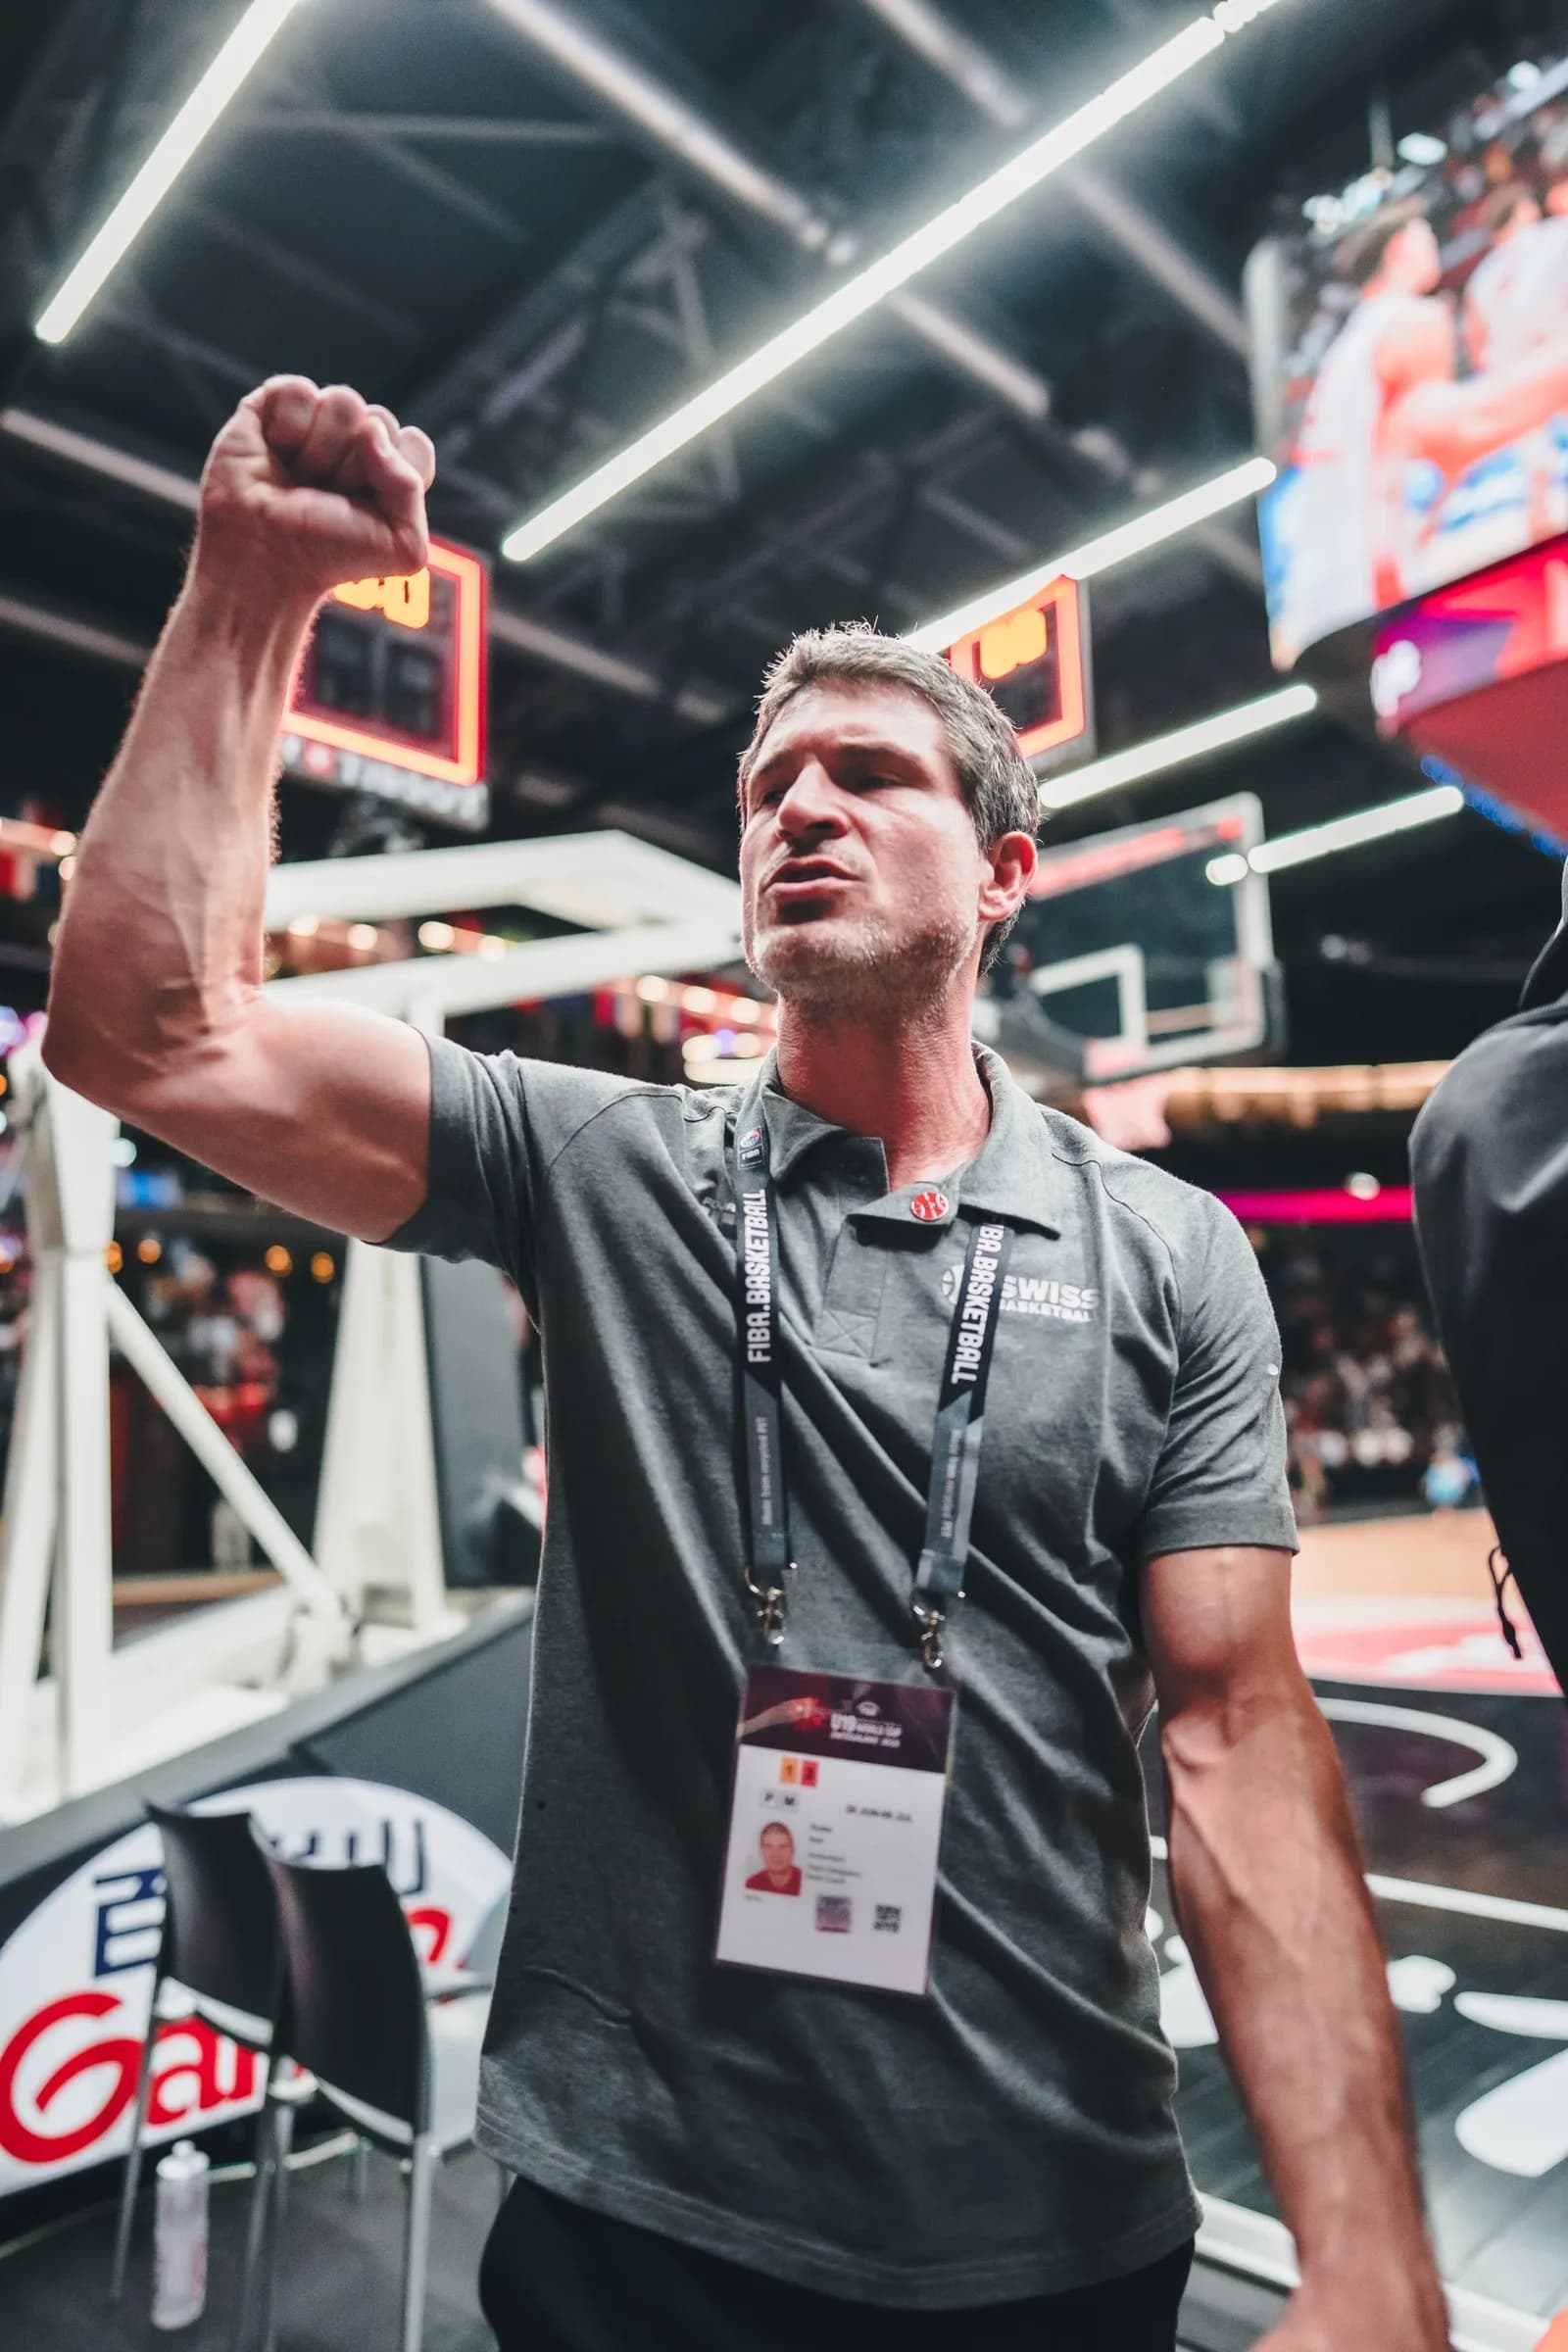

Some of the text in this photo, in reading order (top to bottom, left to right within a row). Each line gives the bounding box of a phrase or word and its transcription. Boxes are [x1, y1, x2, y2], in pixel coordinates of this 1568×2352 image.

[743, 1189, 771, 1363] FIBA.BASKETBALL
[951, 1223, 1004, 1385] IBA.BASKETBALL
[1001, 1275, 1100, 1310] SWISS
